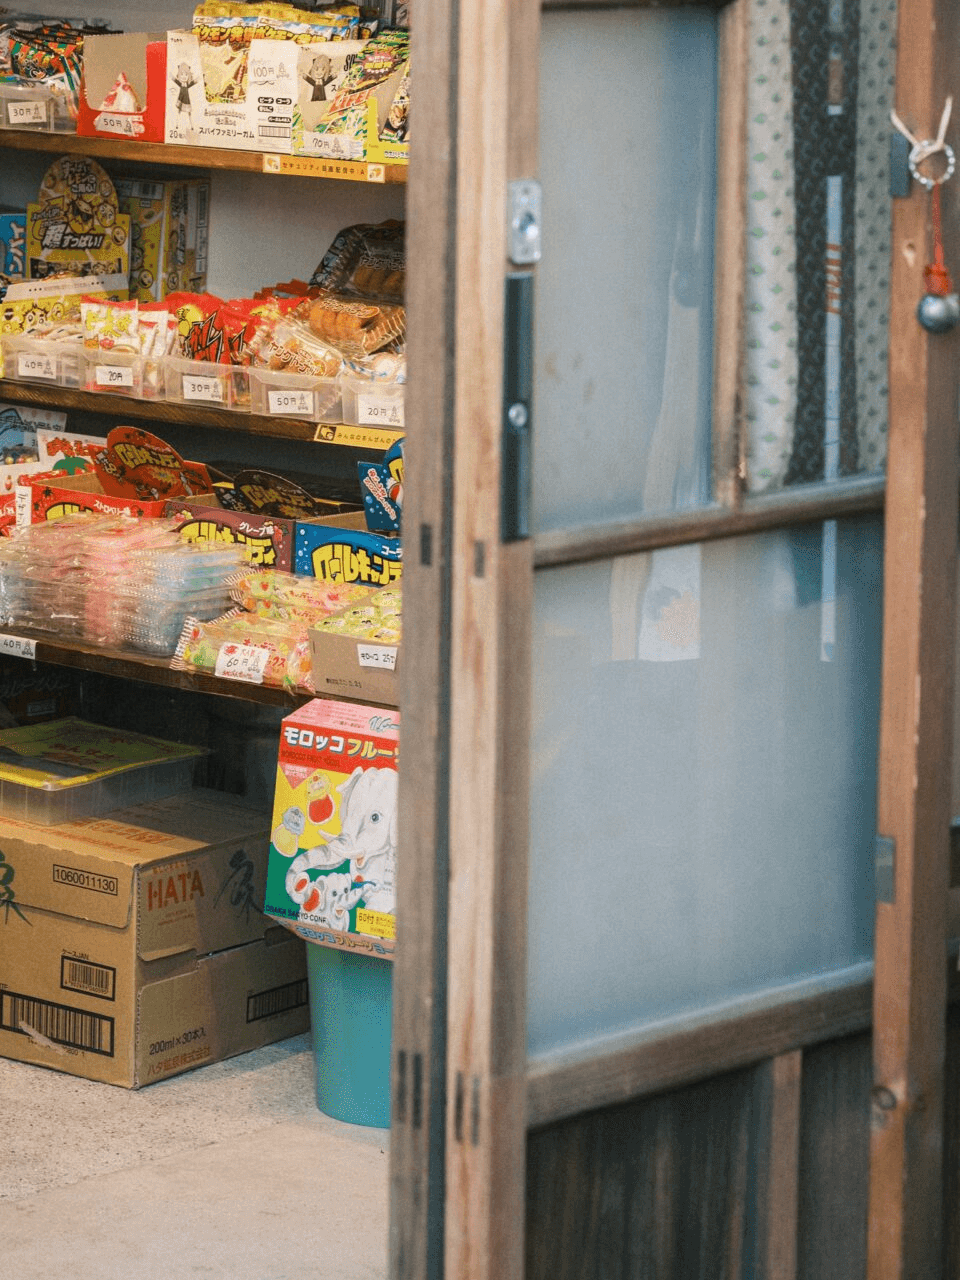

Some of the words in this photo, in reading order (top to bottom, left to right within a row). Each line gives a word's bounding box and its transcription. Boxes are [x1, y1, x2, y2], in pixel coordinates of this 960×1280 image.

[253, 65, 276, 78] 100円
[13, 107, 31, 117] 30円
[103, 117, 123, 128] 50円
[198, 126, 256, 139] スパイファミリーガム
[312, 137, 330, 149] 70円
[24, 361, 43, 369] 40円
[108, 370, 123, 382] 20円
[191, 383, 210, 393] 30円
[277, 397, 296, 407] 50円
[368, 407, 387, 417] 20円
[239, 521, 275, 536] グレープ味
[226, 656, 249, 668] 60円
[54, 868, 116, 893] 1060011130
[147, 870, 206, 911] HATA
[149, 1026, 207, 1056] 200ml×30本入
